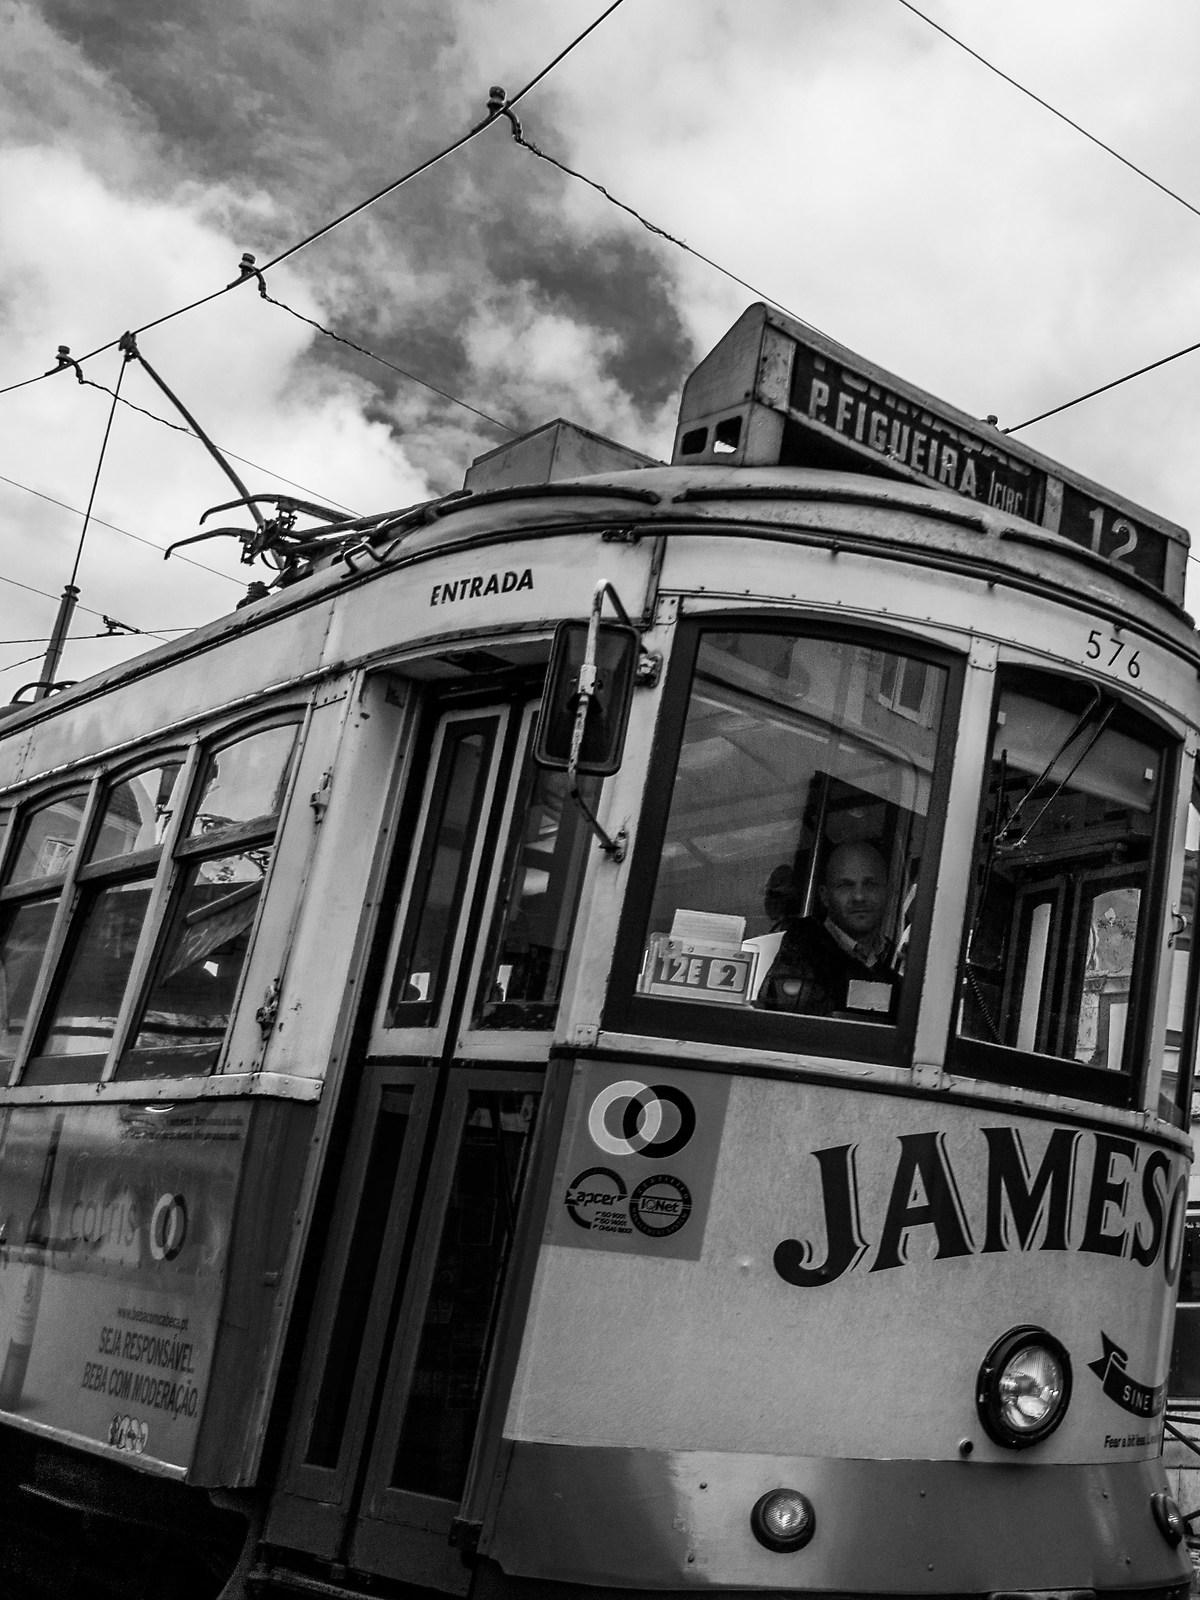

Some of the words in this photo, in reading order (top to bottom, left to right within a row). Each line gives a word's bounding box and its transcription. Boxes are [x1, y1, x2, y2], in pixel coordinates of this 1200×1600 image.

[1089, 507, 1138, 574] 12
[430, 568, 534, 607] ENTRADA
[1086, 630, 1140, 678] 576
[660, 956, 703, 985] 12E
[718, 964, 737, 987] 2
[98, 1326, 122, 1356] SEJA
[81, 1361, 109, 1393] BEBA
[108, 1368, 133, 1400] COM
[1122, 1384, 1151, 1411] SINE
